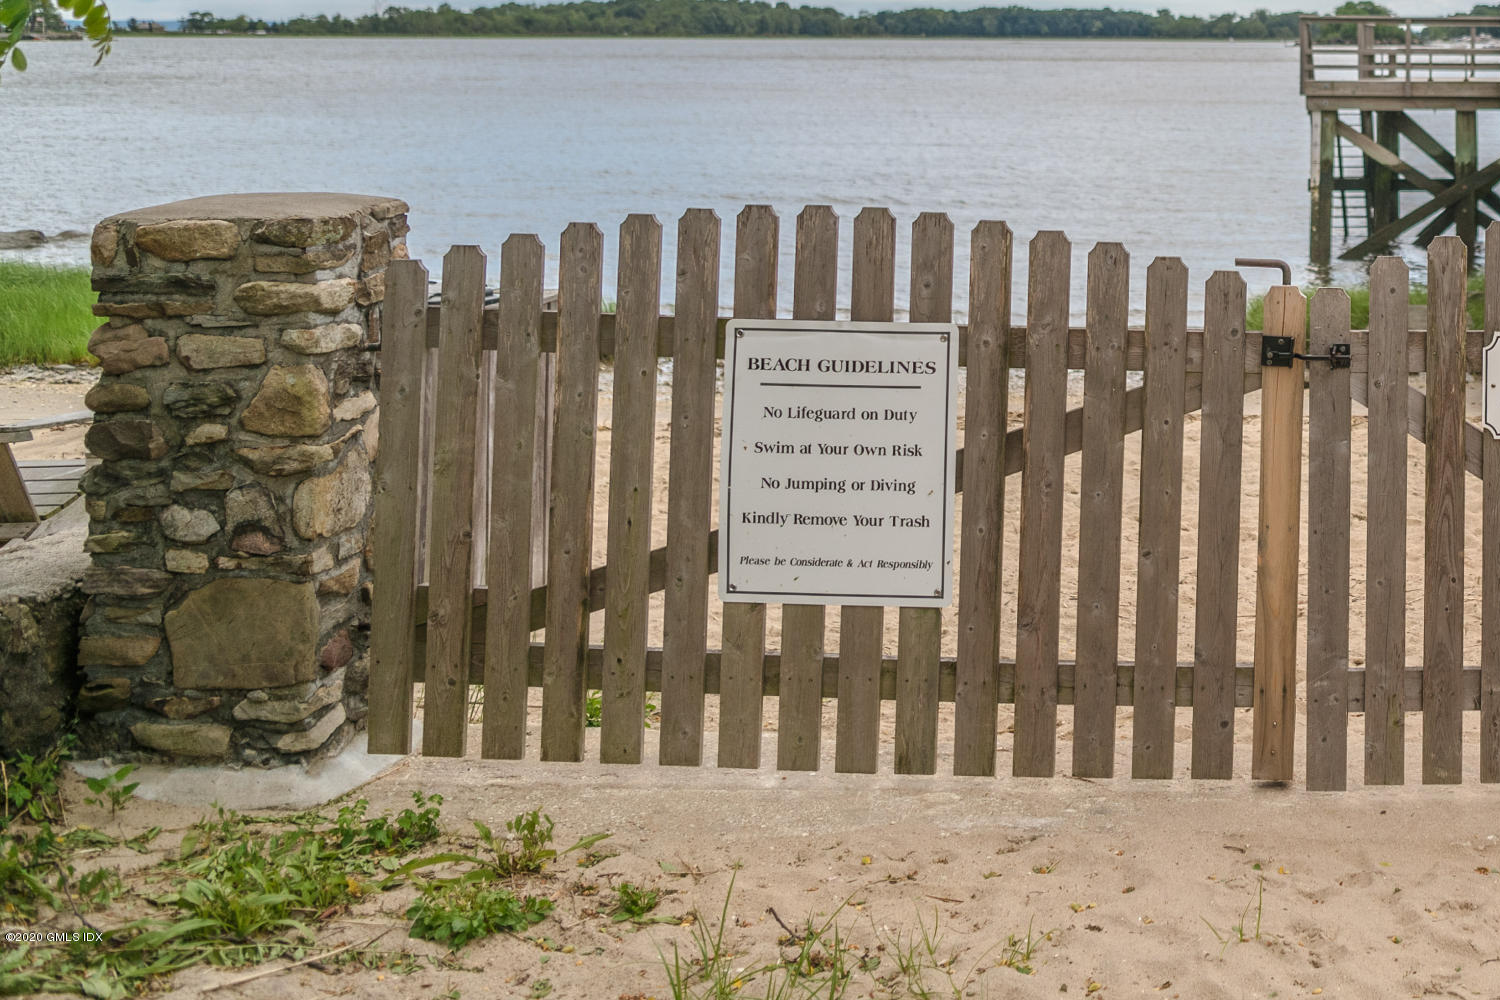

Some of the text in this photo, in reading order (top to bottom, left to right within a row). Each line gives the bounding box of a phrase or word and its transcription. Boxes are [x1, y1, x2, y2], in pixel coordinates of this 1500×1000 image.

[747, 358, 937, 375] BEACH GUIDELINES
[763, 406, 917, 423] No Lifeguard on Duty
[754, 441, 923, 457] Swim at Your Own Risk
[761, 477, 916, 495] No Jumping or Diving
[741, 511, 930, 528] Kindly Remove Your Trash
[740, 556, 934, 571] Please be Considerate & Act Responsibly
